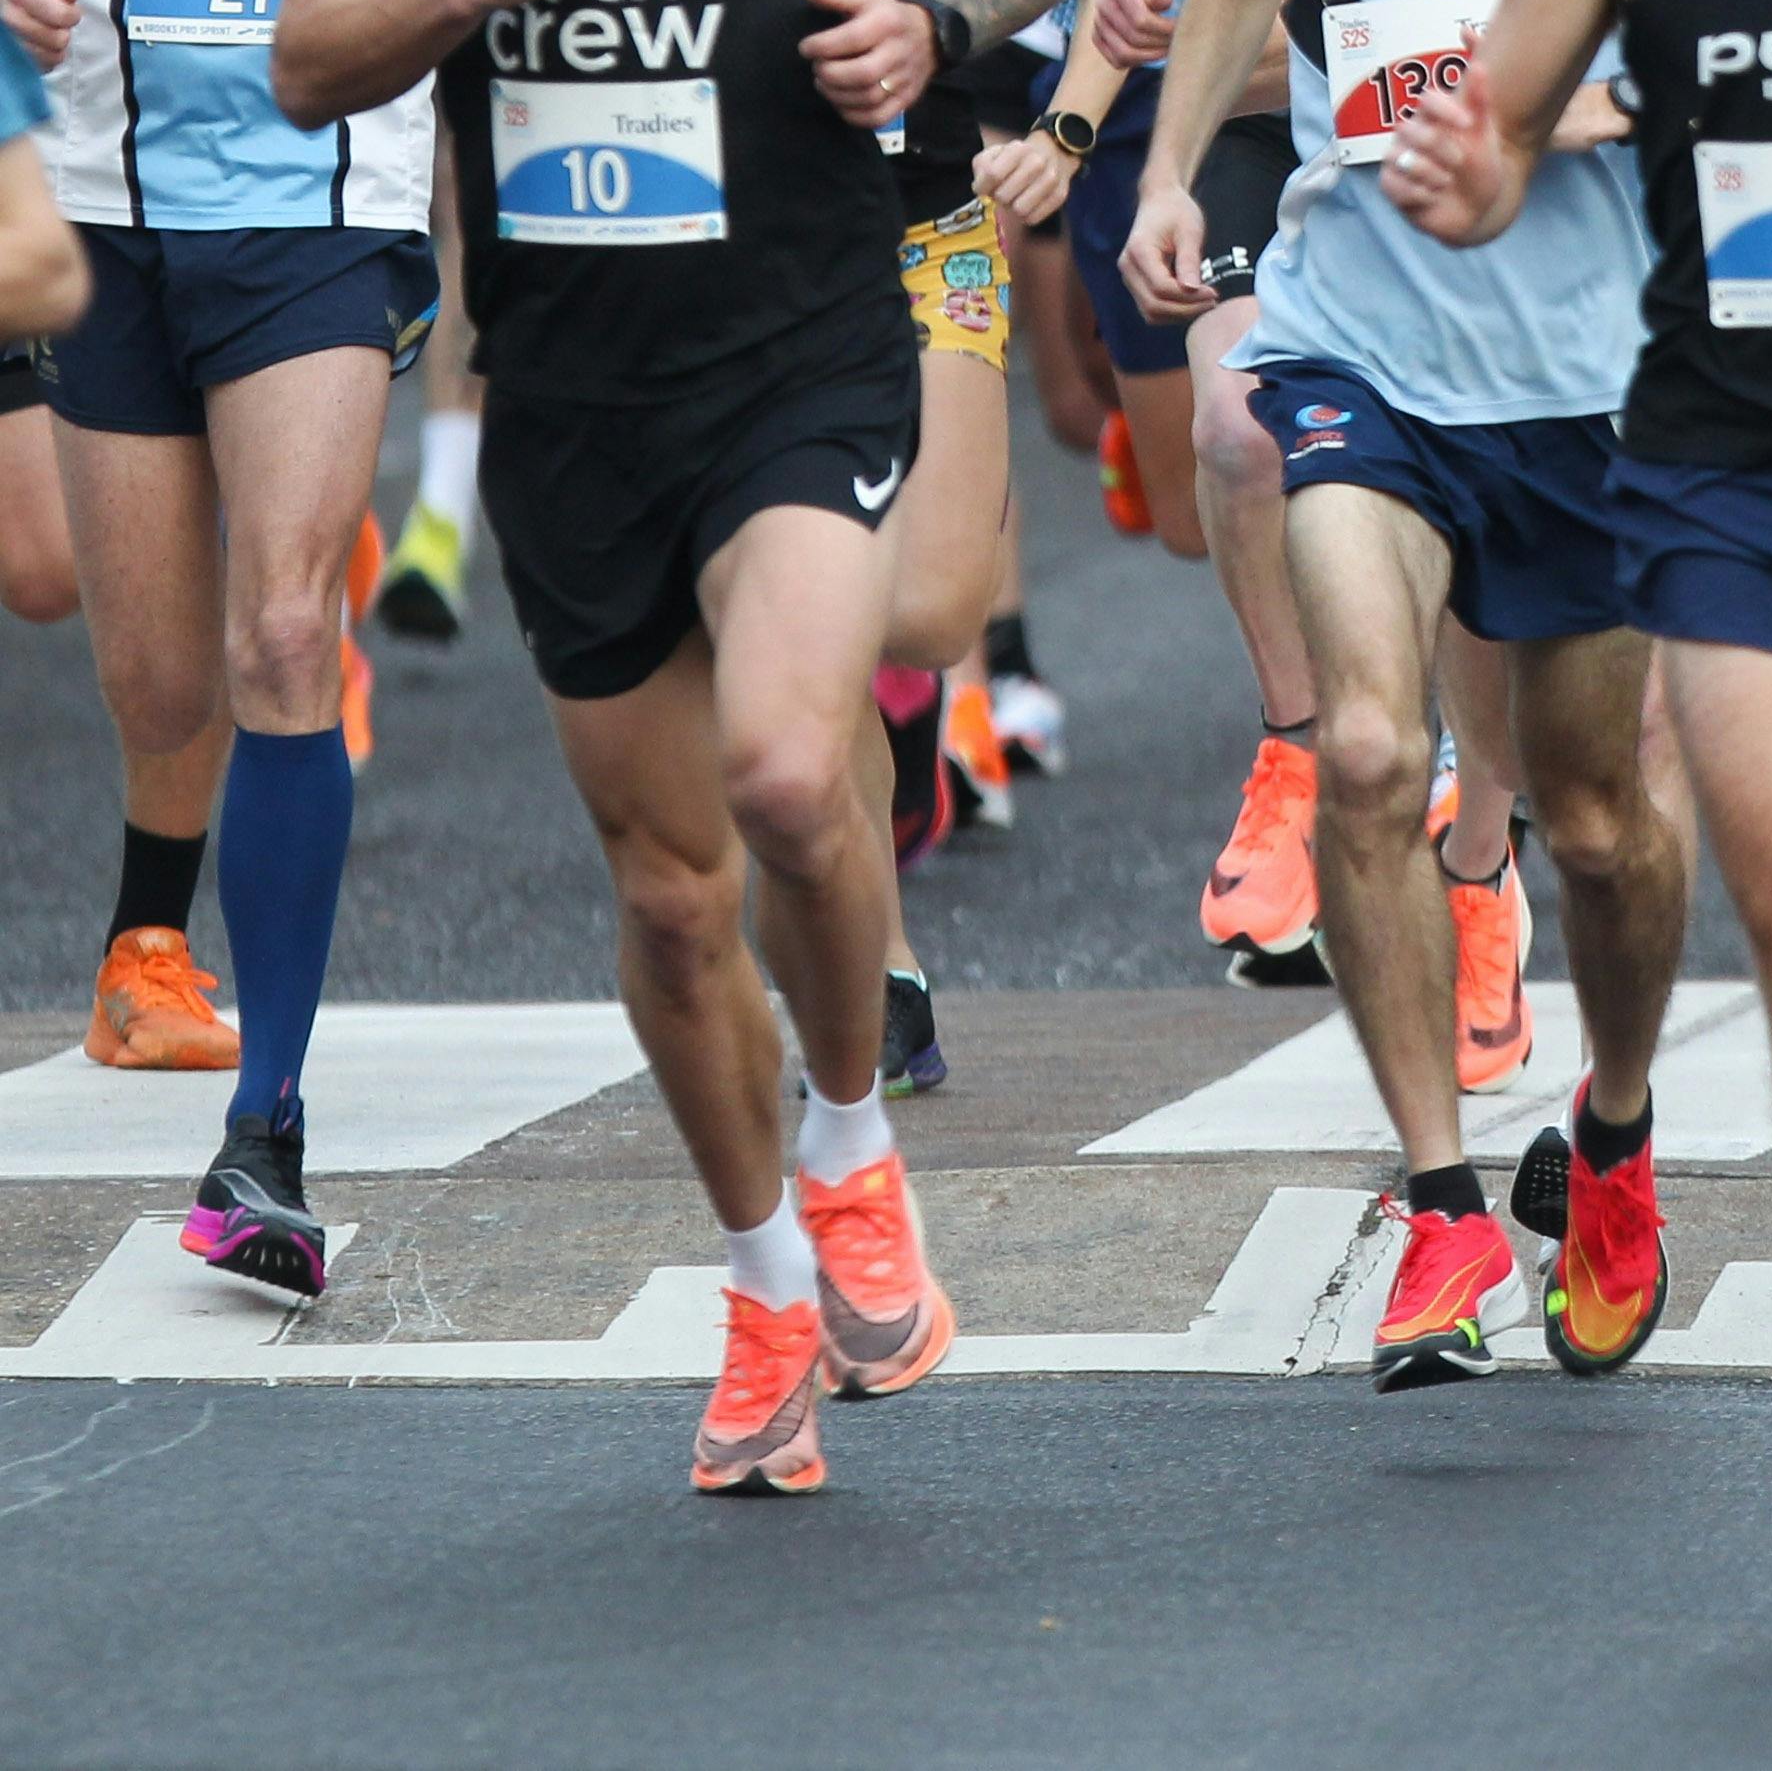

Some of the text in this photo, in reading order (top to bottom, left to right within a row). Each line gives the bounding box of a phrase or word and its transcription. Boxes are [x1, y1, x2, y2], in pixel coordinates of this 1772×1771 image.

[486, 2, 725, 72] crew
[1340, 29, 1370, 49] S2S
[613, 113, 695, 135] Tradies
[562, 148, 631, 214] 10
